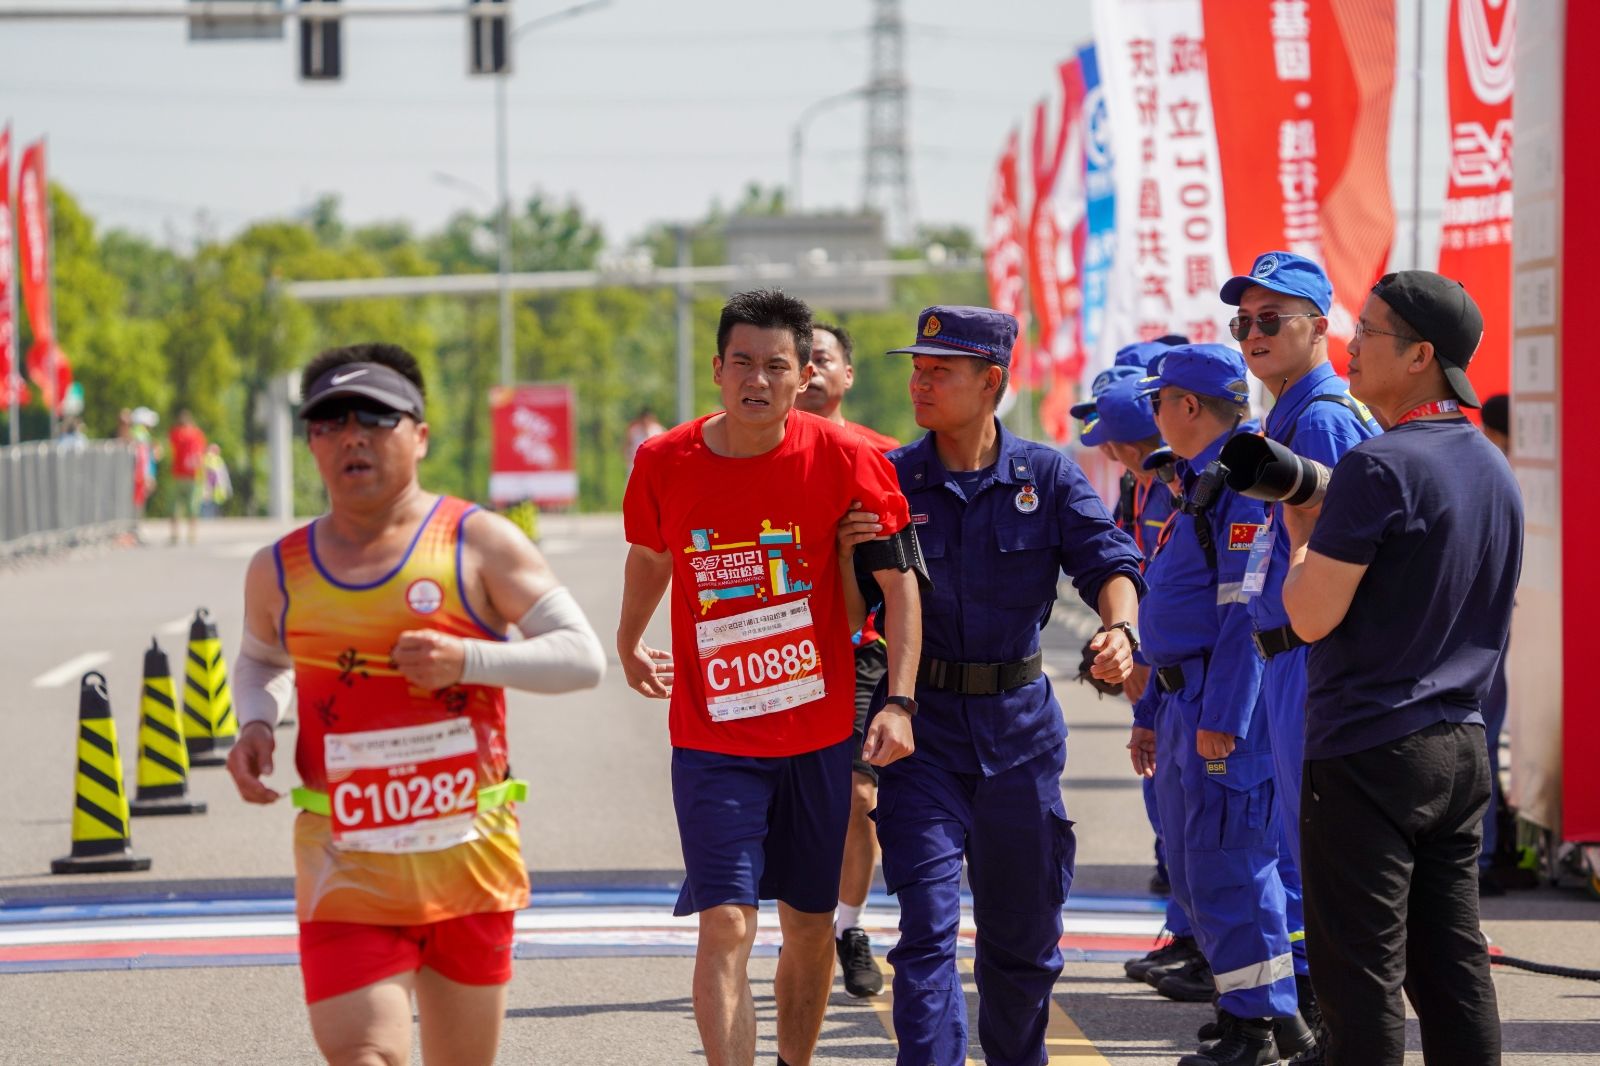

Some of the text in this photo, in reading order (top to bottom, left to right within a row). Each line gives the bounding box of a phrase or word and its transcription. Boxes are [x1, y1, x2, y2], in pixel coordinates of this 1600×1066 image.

[721, 550, 762, 568] 2021
[707, 639, 817, 691] C10889
[1208, 763, 1224, 771] BSR
[334, 768, 476, 826] C10282
